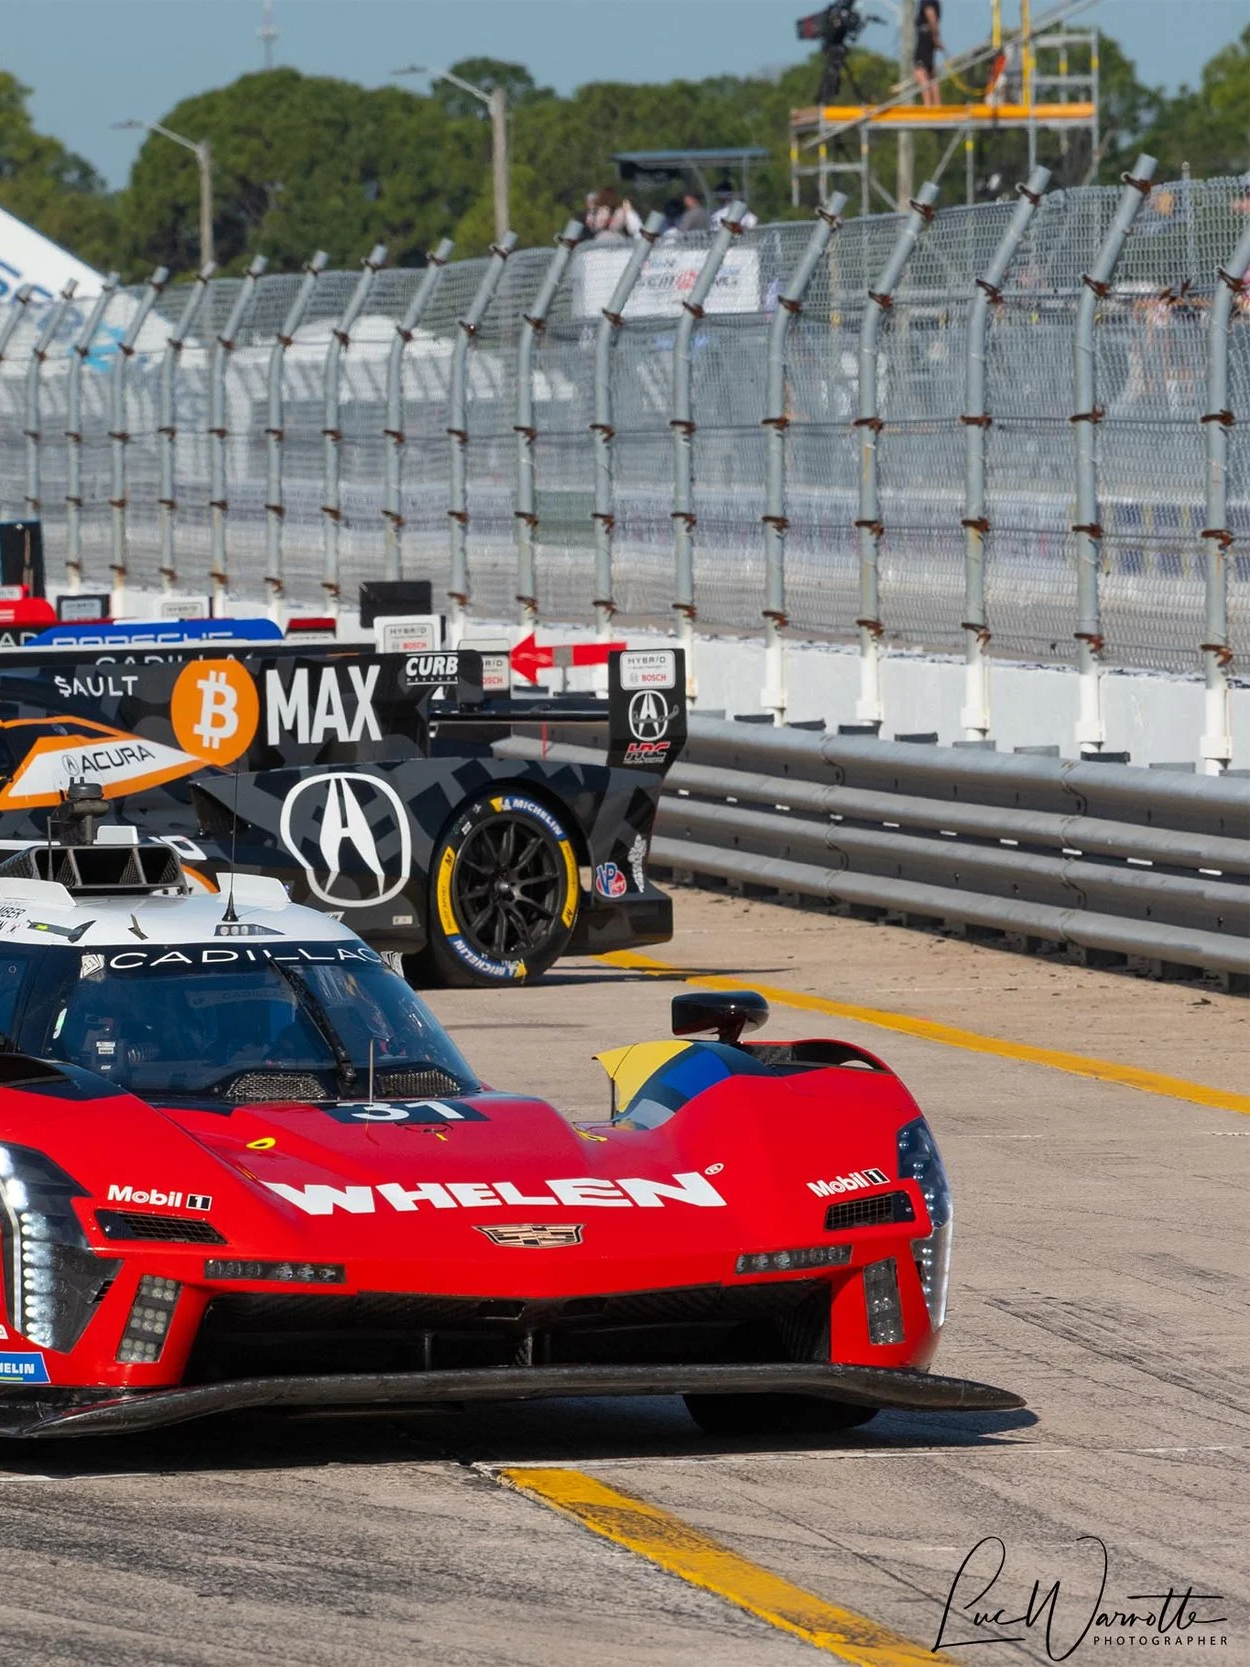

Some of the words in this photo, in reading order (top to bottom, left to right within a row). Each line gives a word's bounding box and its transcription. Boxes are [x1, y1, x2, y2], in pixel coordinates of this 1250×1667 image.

[402, 642, 427, 650] BOSCH
[406, 657, 458, 676] CURB
[641, 674, 667, 682] BOSCH
[265, 665, 383, 746] MAX
[81, 744, 155, 773] ACURA
[512, 799, 563, 836] MICHELIN
[453, 939, 506, 977] MICHELIN
[337, 1100, 465, 1121] 31
[107, 1183, 183, 1208] Mobil
[806, 1171, 869, 1198] Mobil
